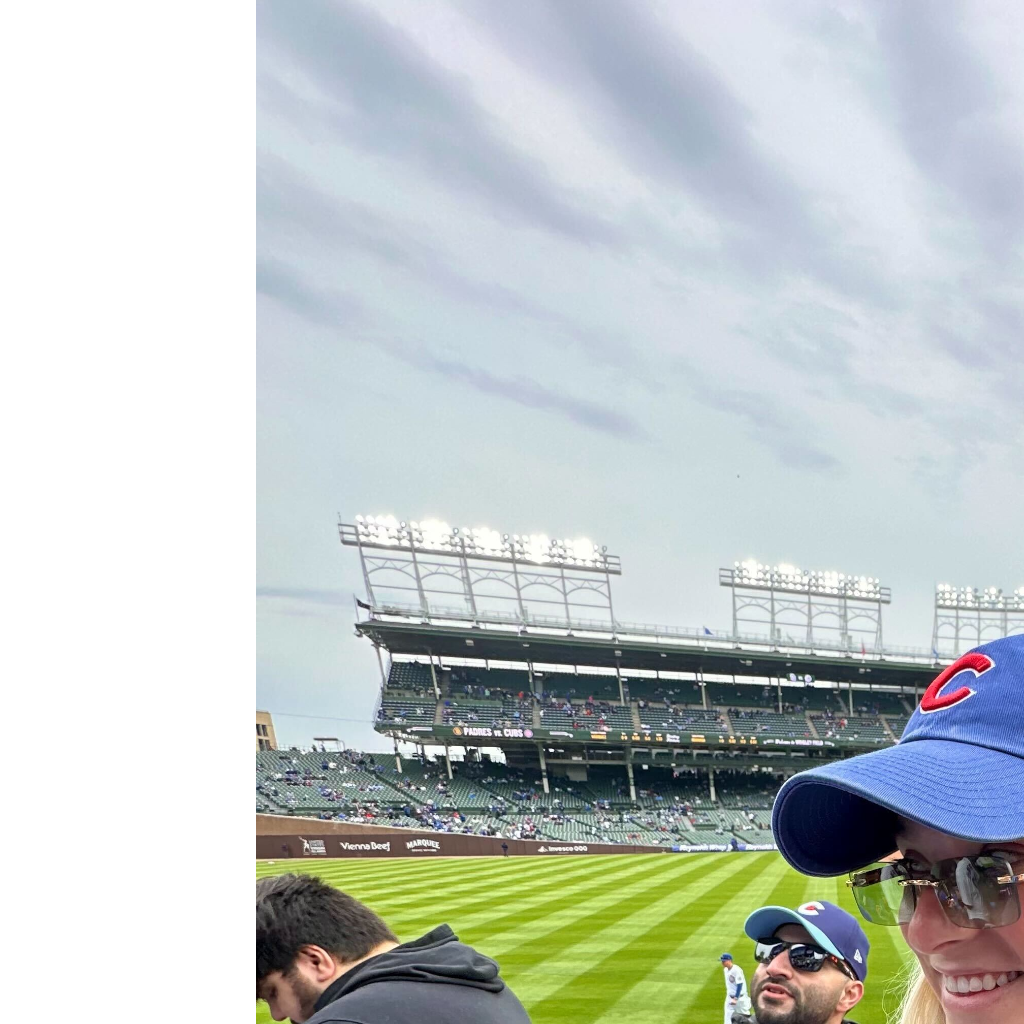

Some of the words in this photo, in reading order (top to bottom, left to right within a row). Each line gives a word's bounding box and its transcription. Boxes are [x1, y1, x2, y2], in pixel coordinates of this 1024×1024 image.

[919, 652, 996, 714] C
[463, 727, 492, 737] PADRES
[504, 728, 523, 738] CUBS
[340, 841, 370, 851] Vienna
[371, 841, 390, 852] Beef
[406, 838, 441, 850] MARQUEE
